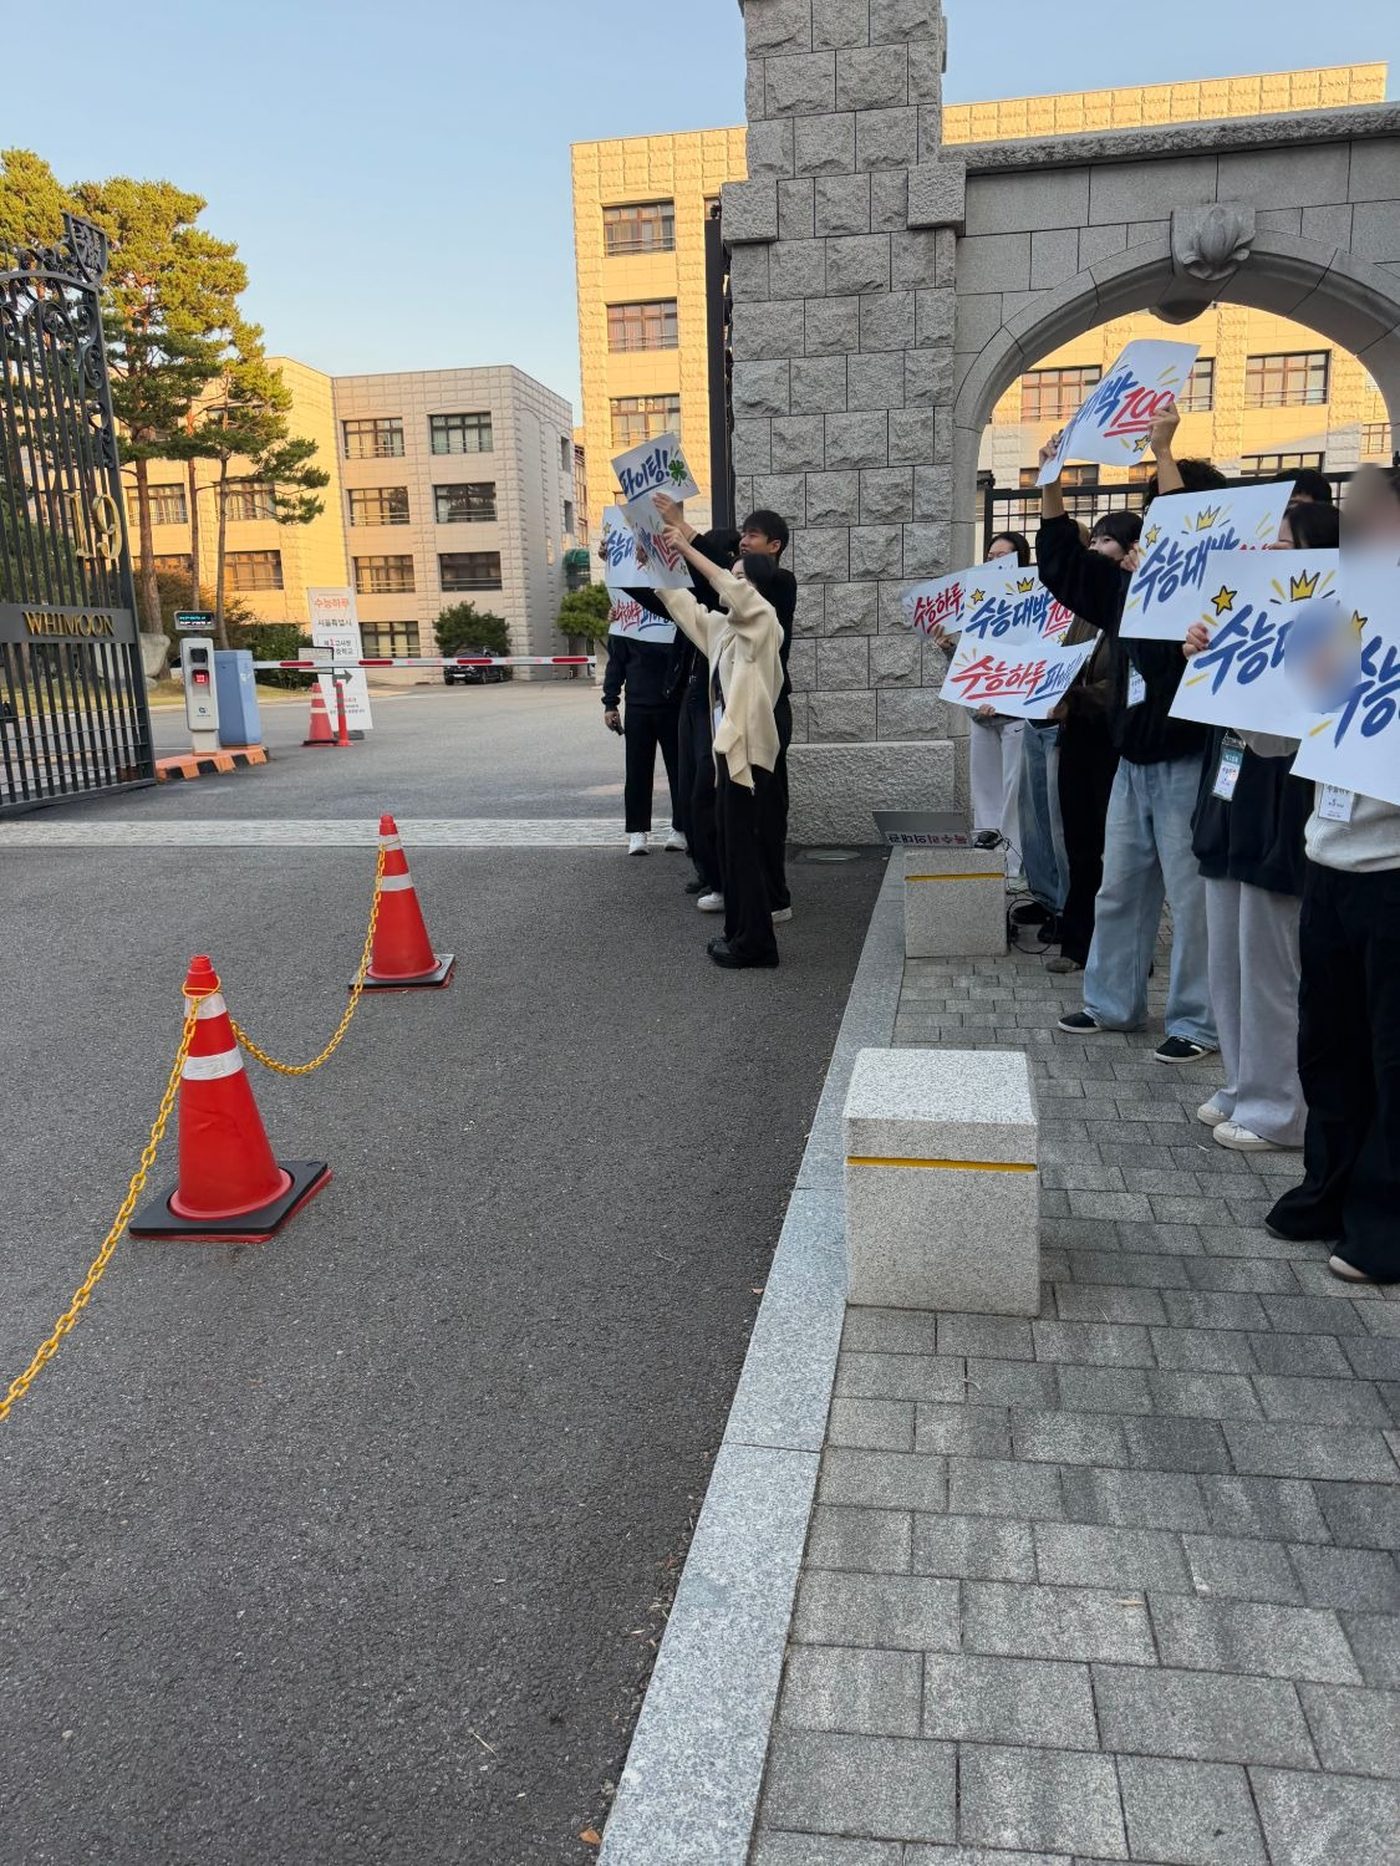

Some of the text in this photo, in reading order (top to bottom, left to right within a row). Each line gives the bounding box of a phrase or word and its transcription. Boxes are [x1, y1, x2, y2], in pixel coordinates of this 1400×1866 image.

[618, 448, 671, 496] 파이팅!
[64, 491, 122, 560] 19
[23, 611, 115, 637] WHIMOON
[914, 582, 964, 634] 수능하루
[966, 590, 1055, 639] 수능대박
[1192, 604, 1294, 695] 수능
[950, 656, 1048, 699] 수능하루
